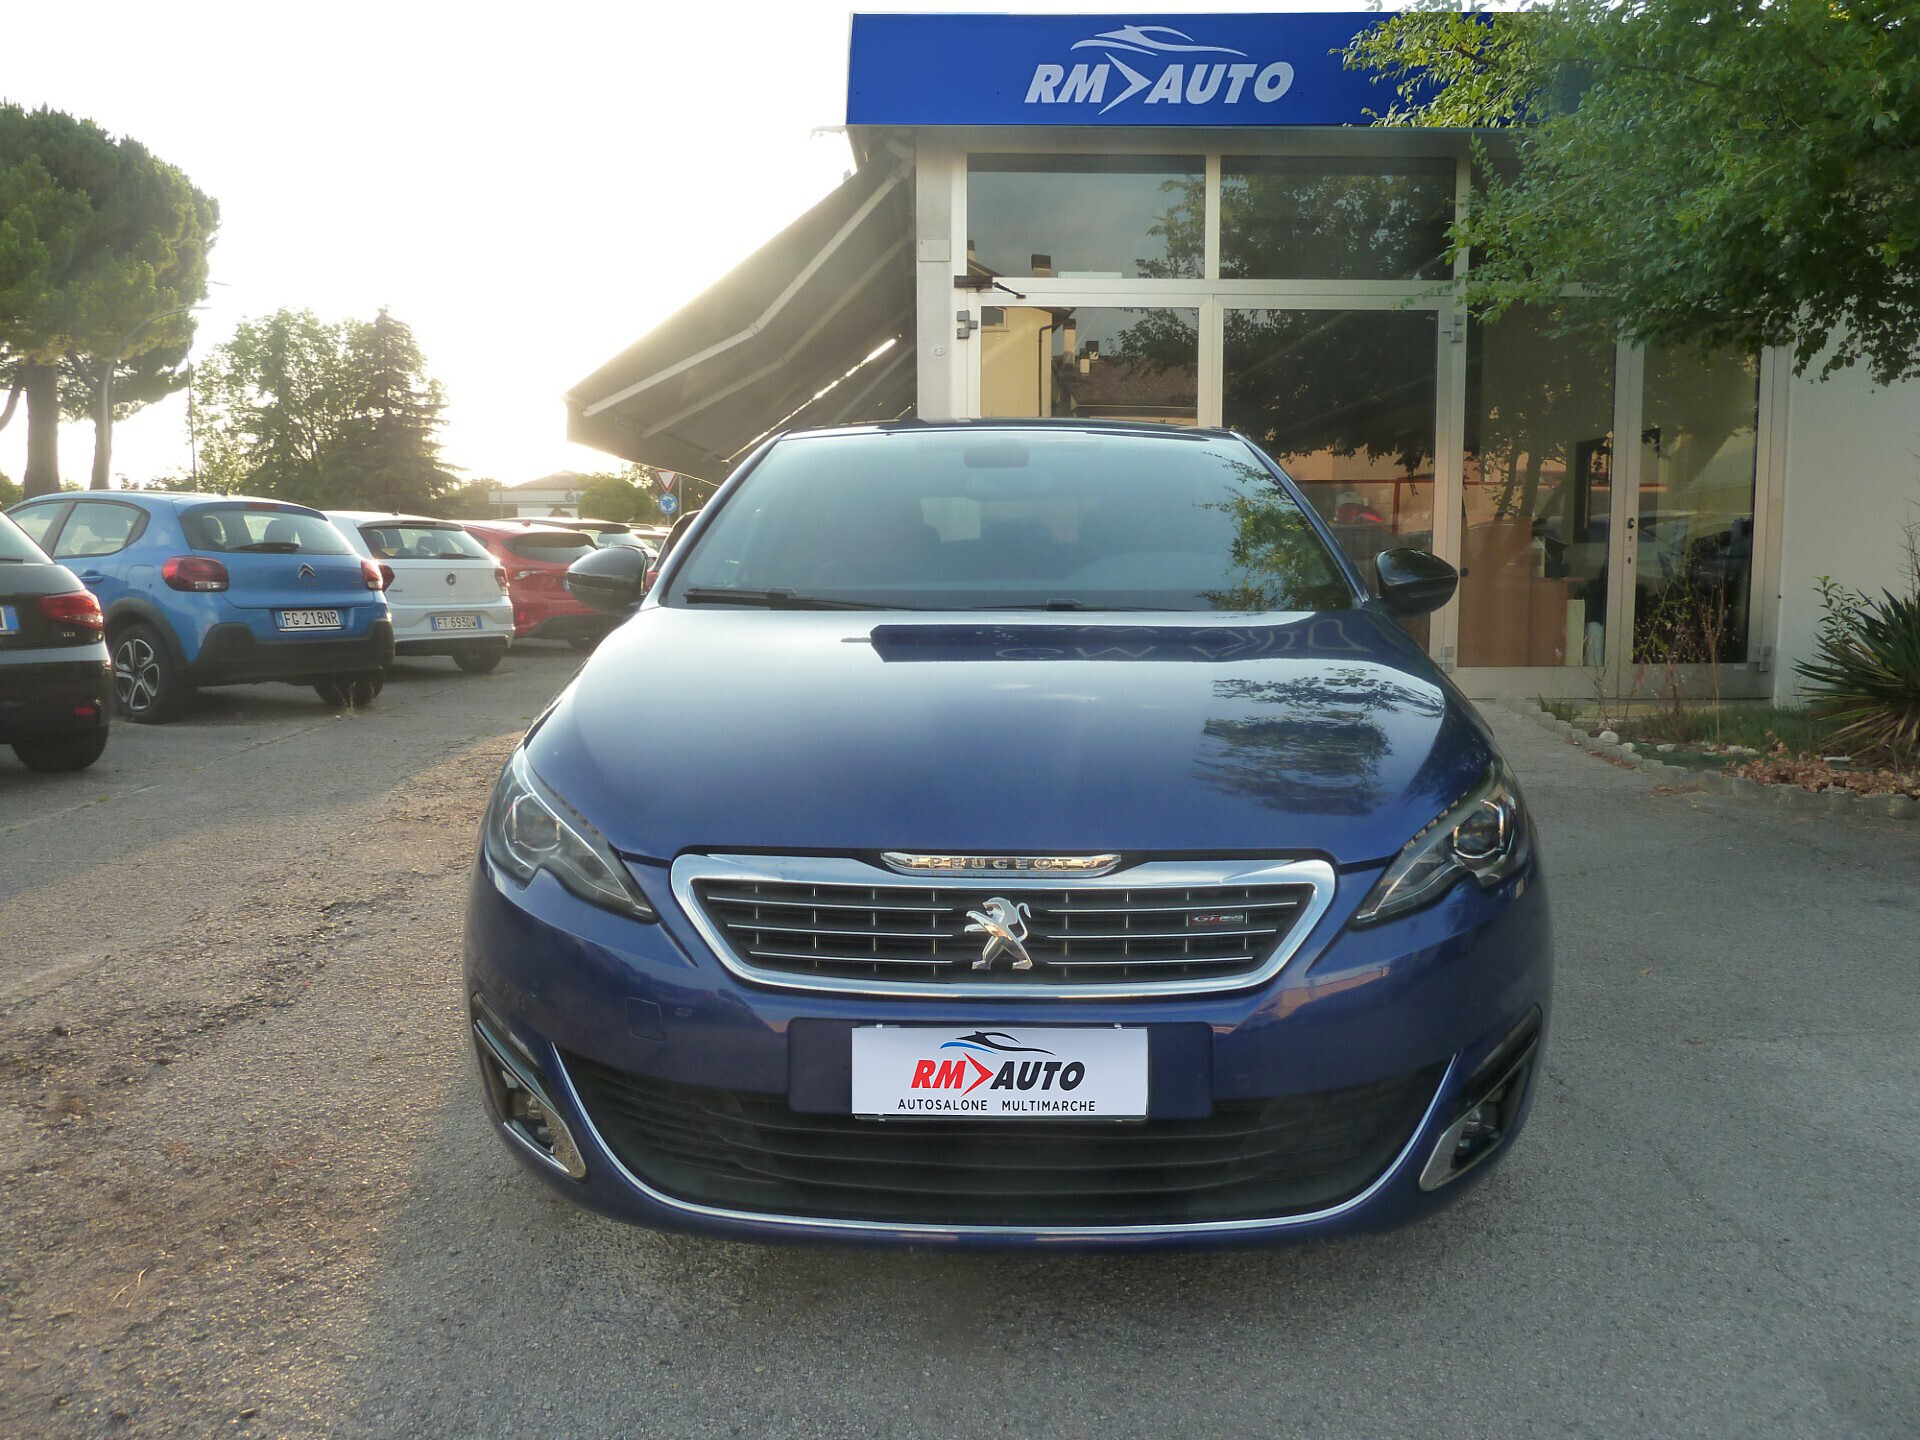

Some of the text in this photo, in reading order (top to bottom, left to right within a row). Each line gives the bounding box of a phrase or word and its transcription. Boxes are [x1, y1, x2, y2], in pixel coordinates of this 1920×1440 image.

[1024, 61, 1294, 104] RM AUTO
[929, 857, 1072, 870] PEUGEOT
[911, 1059, 1085, 1091] RM AUTO
[898, 1098, 1096, 1112] AUTOSALONE MULTIMARCHE
